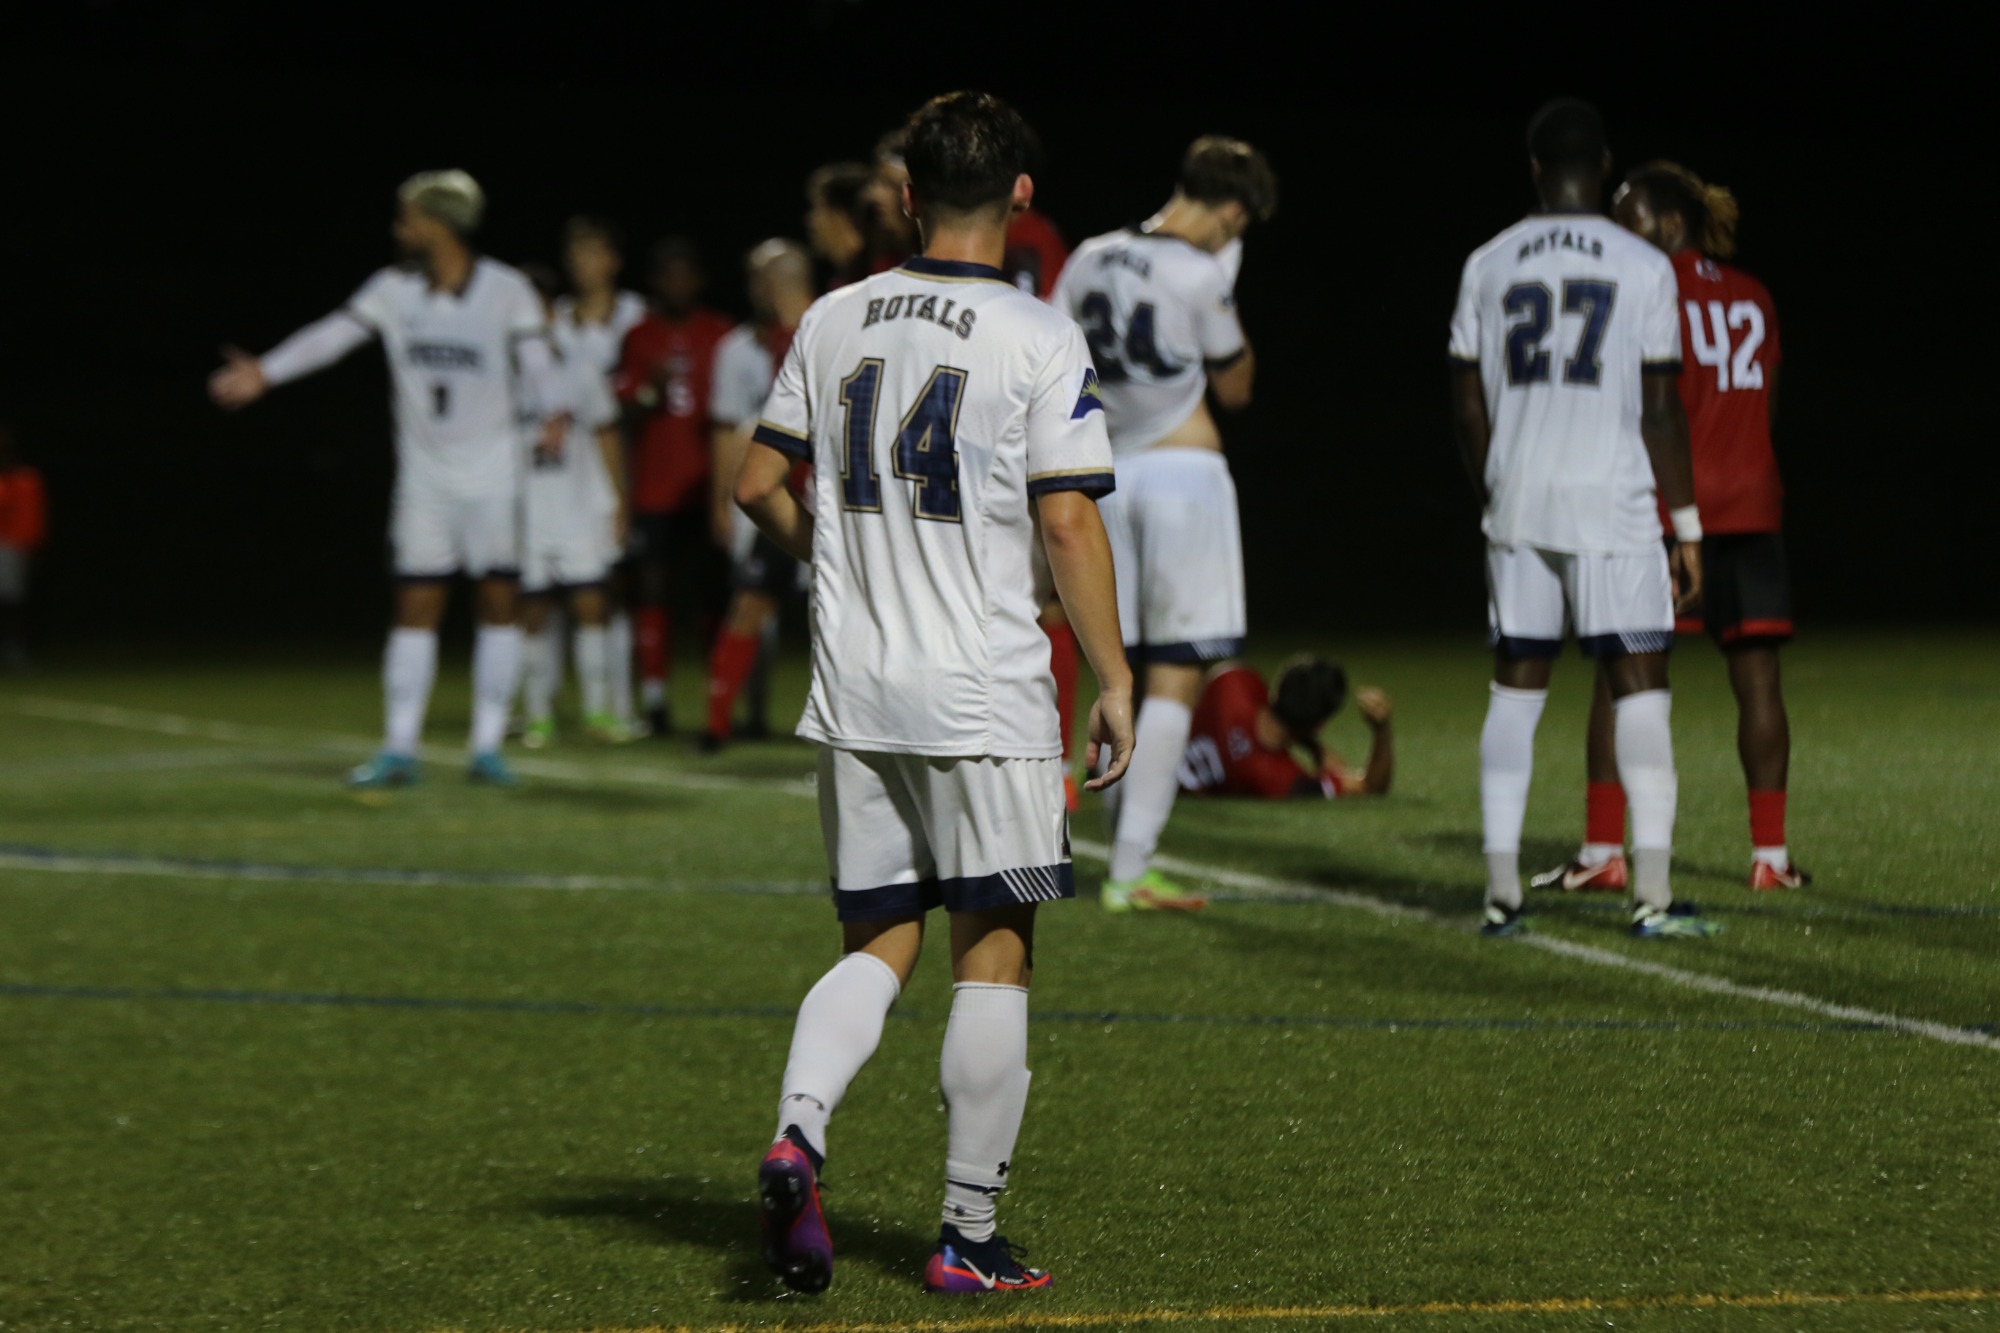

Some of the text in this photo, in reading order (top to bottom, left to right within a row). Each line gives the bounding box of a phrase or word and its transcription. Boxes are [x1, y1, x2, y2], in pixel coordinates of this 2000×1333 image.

[862, 294, 976, 340] ROYALS
[1079, 290, 1186, 382] 24
[1503, 279, 1618, 387] 27
[1686, 300, 1765, 391] 42
[839, 357, 969, 524] 14
